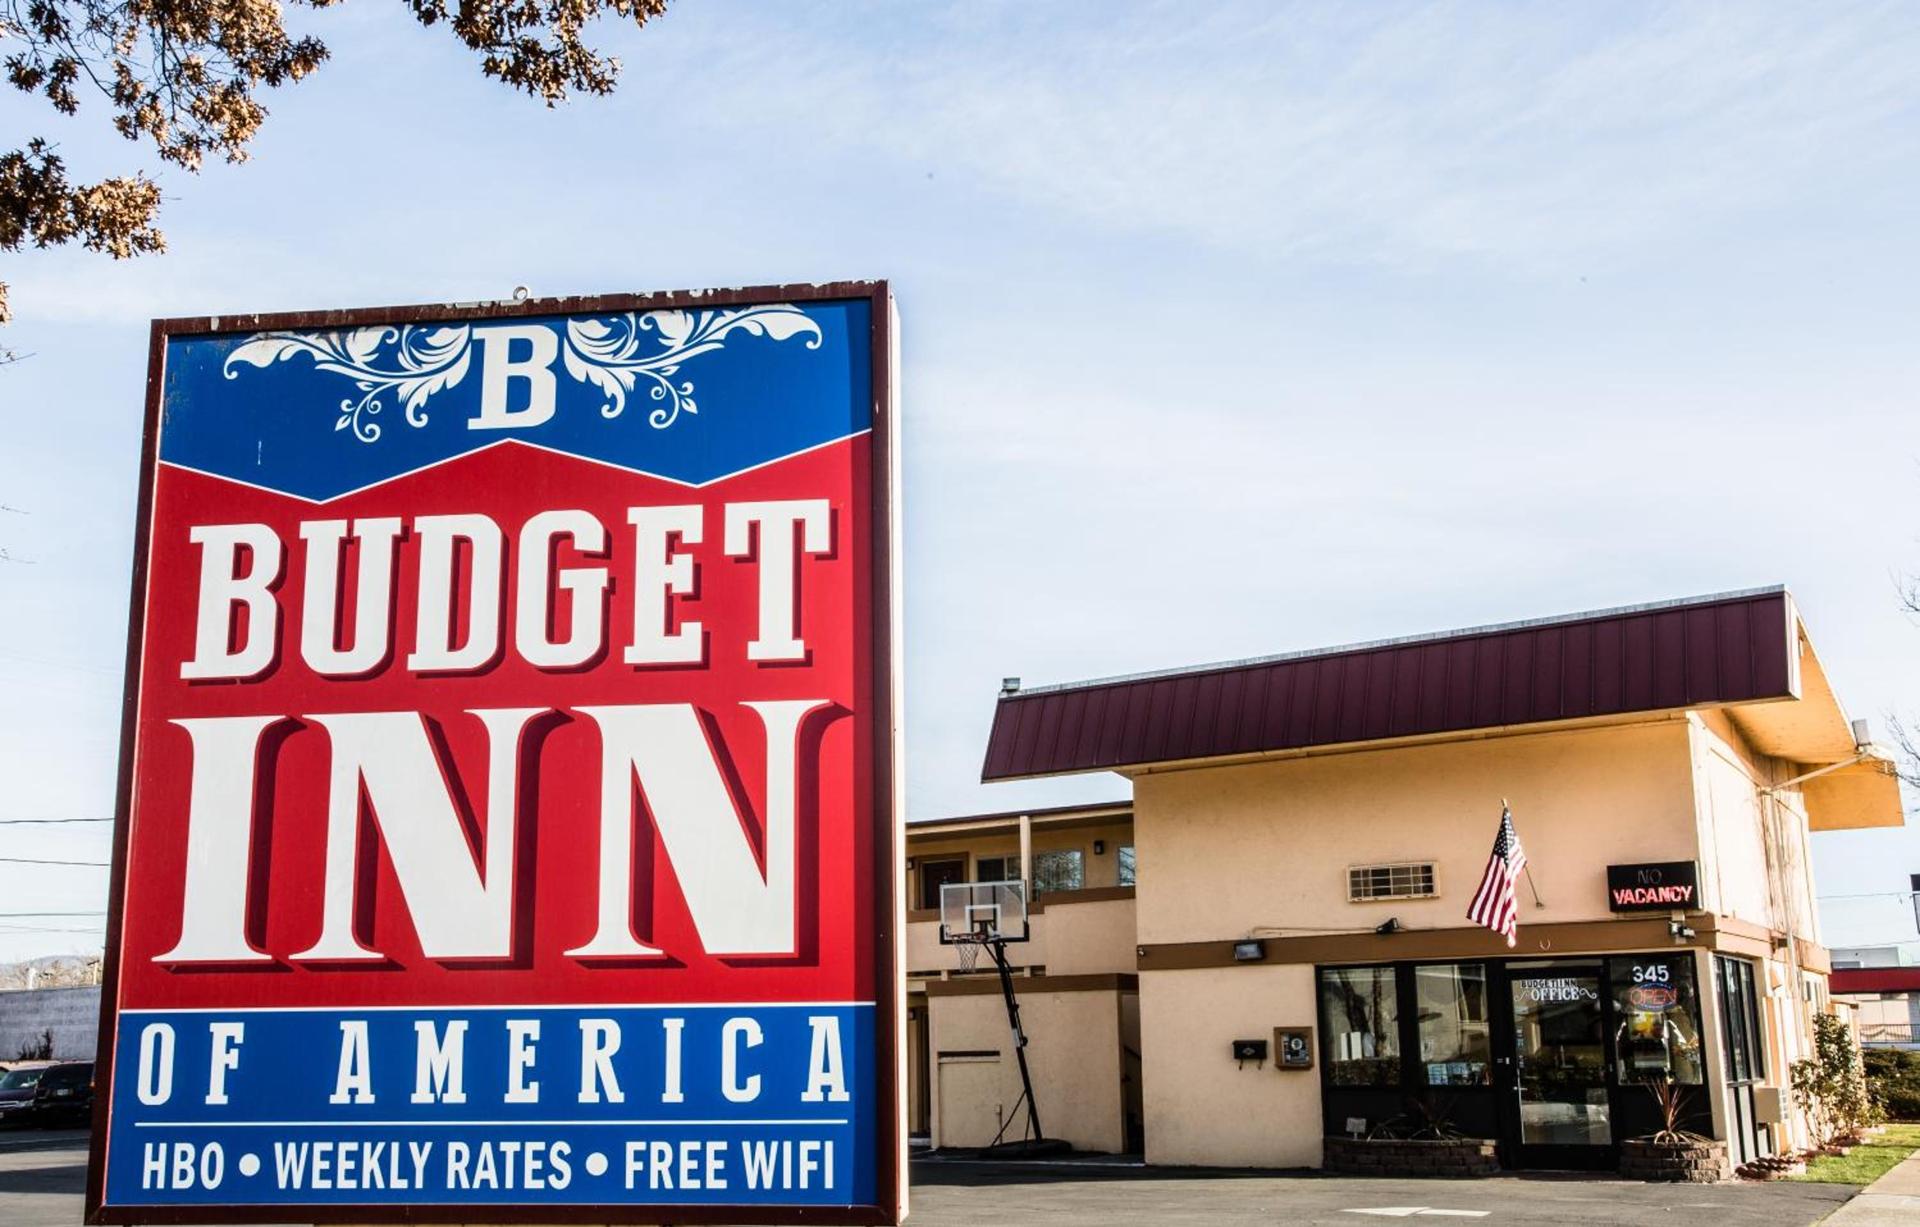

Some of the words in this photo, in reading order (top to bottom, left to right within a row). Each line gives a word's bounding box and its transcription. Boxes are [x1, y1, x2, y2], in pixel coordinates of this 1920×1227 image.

[468, 325, 558, 429] B
[181, 499, 832, 681] BUDGET
[152, 700, 836, 962] INN
[1637, 869, 1662, 884] NO
[1613, 886, 1692, 904] VACANCY
[1632, 965, 1670, 982] 345
[1531, 987, 1580, 1001] OFFICE
[1630, 988, 1677, 1005] OPEN
[138, 1022, 245, 1106] OF
[330, 1016, 849, 1105] AMERICA
[143, 1142, 224, 1190] HBO
[275, 1141, 433, 1189] WEEKLY
[448, 1141, 571, 1190] RATES
[626, 1141, 727, 1189] FREE
[743, 1141, 834, 1189] WIFI
